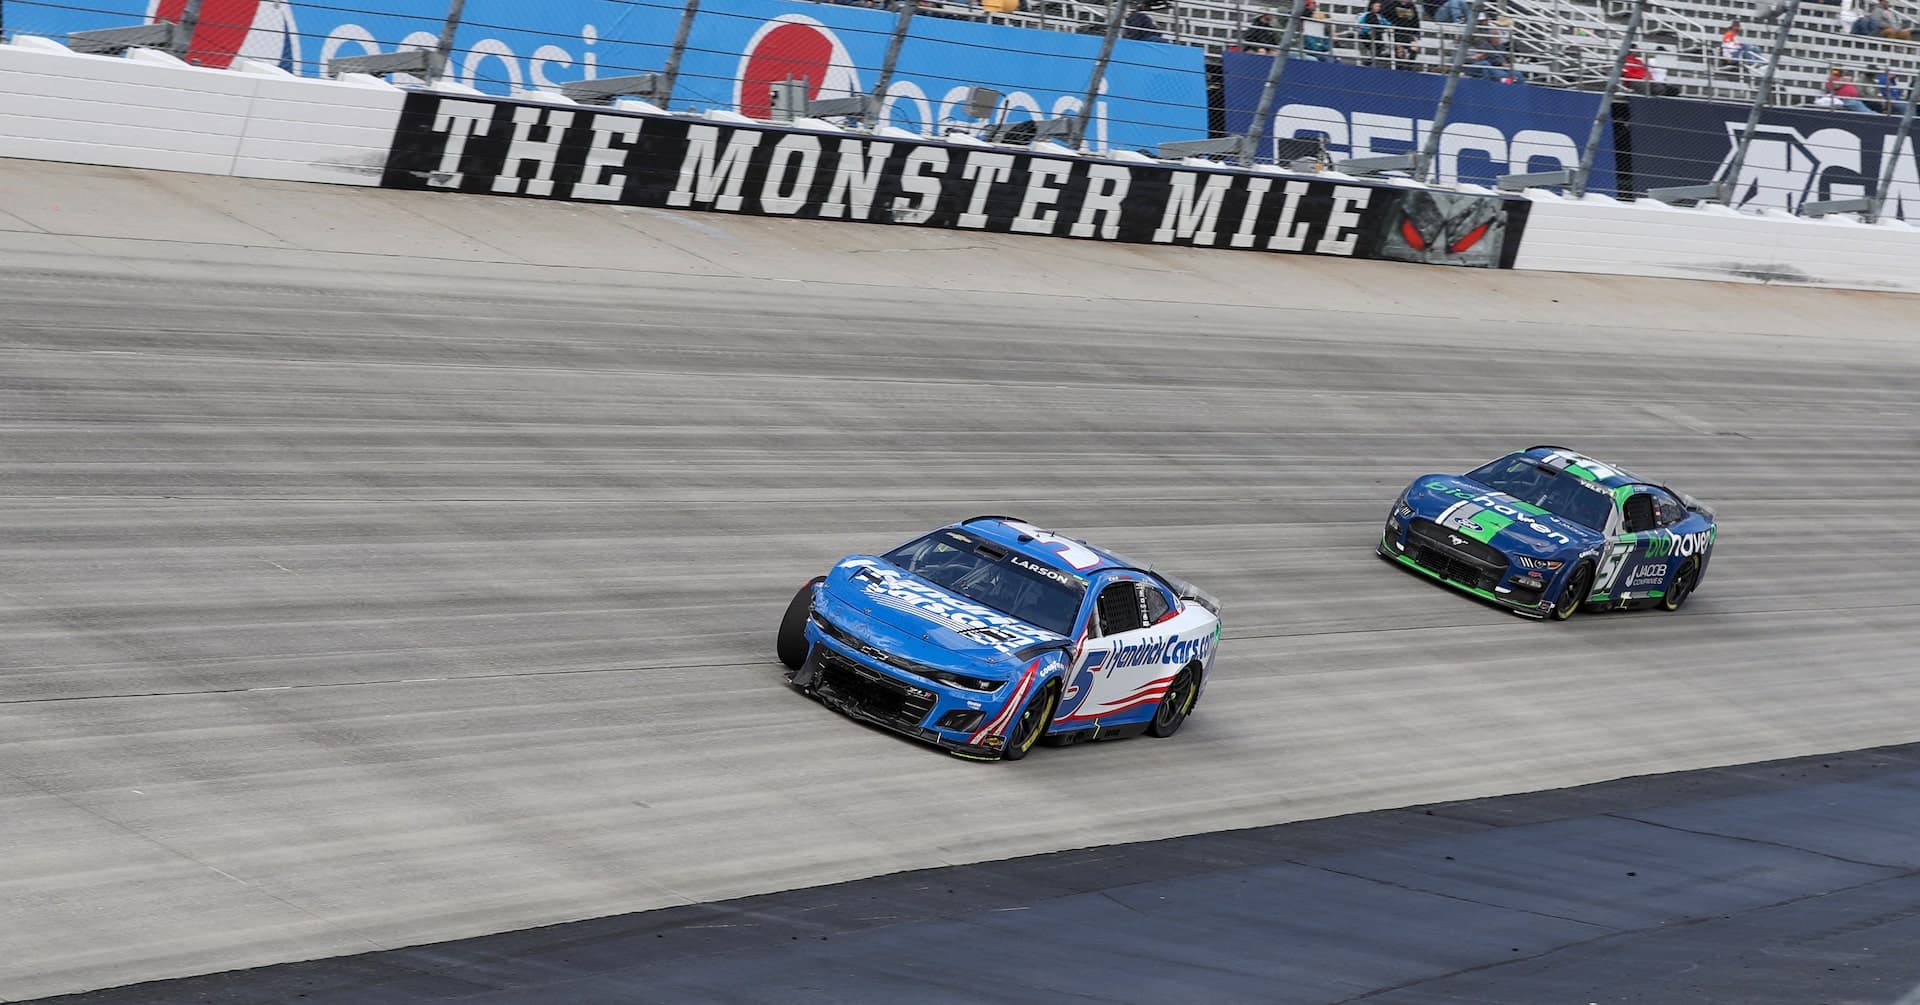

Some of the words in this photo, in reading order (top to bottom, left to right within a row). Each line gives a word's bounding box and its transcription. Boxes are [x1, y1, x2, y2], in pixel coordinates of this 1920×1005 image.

[431, 99, 643, 203] THE
[666, 124, 1132, 240] MONSTER
[1152, 171, 1372, 257] MILE
[1273, 103, 1579, 189] GEICO
[1425, 480, 1570, 545] biohaven
[1010, 556, 1068, 584] LARSON
[1636, 563, 1668, 578] JACOB
[1053, 649, 1111, 722] 5
